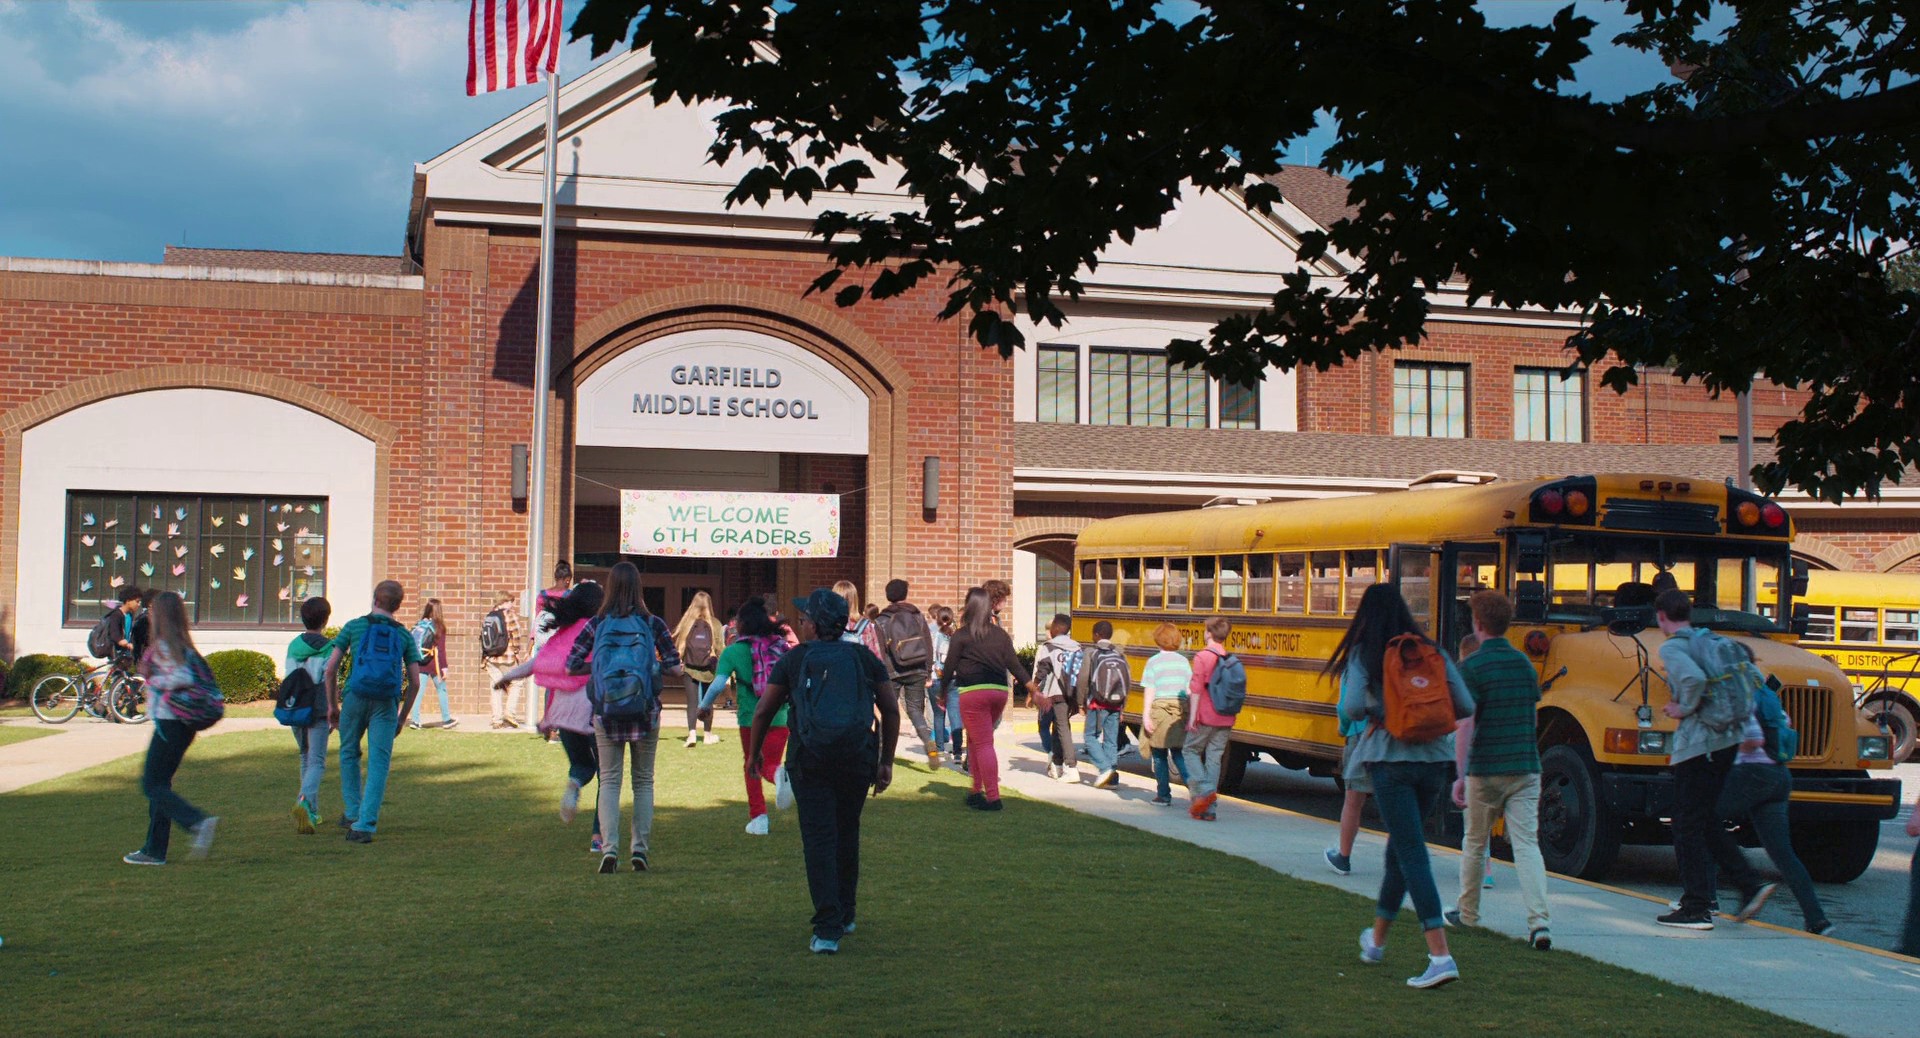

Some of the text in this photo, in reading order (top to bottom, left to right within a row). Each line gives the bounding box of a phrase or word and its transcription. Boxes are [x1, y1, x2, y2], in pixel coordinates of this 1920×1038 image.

[671, 365, 781, 388] GARFIELD
[633, 393, 818, 420] MIDDLE SCHOOL
[668, 505, 790, 525] WELCOME
[653, 527, 812, 545] 6TH GRADERS
[1231, 631, 1261, 649] SCHOOL
[1265, 633, 1301, 651] DISTRICT
[1848, 654, 1895, 667] DISTRICT
